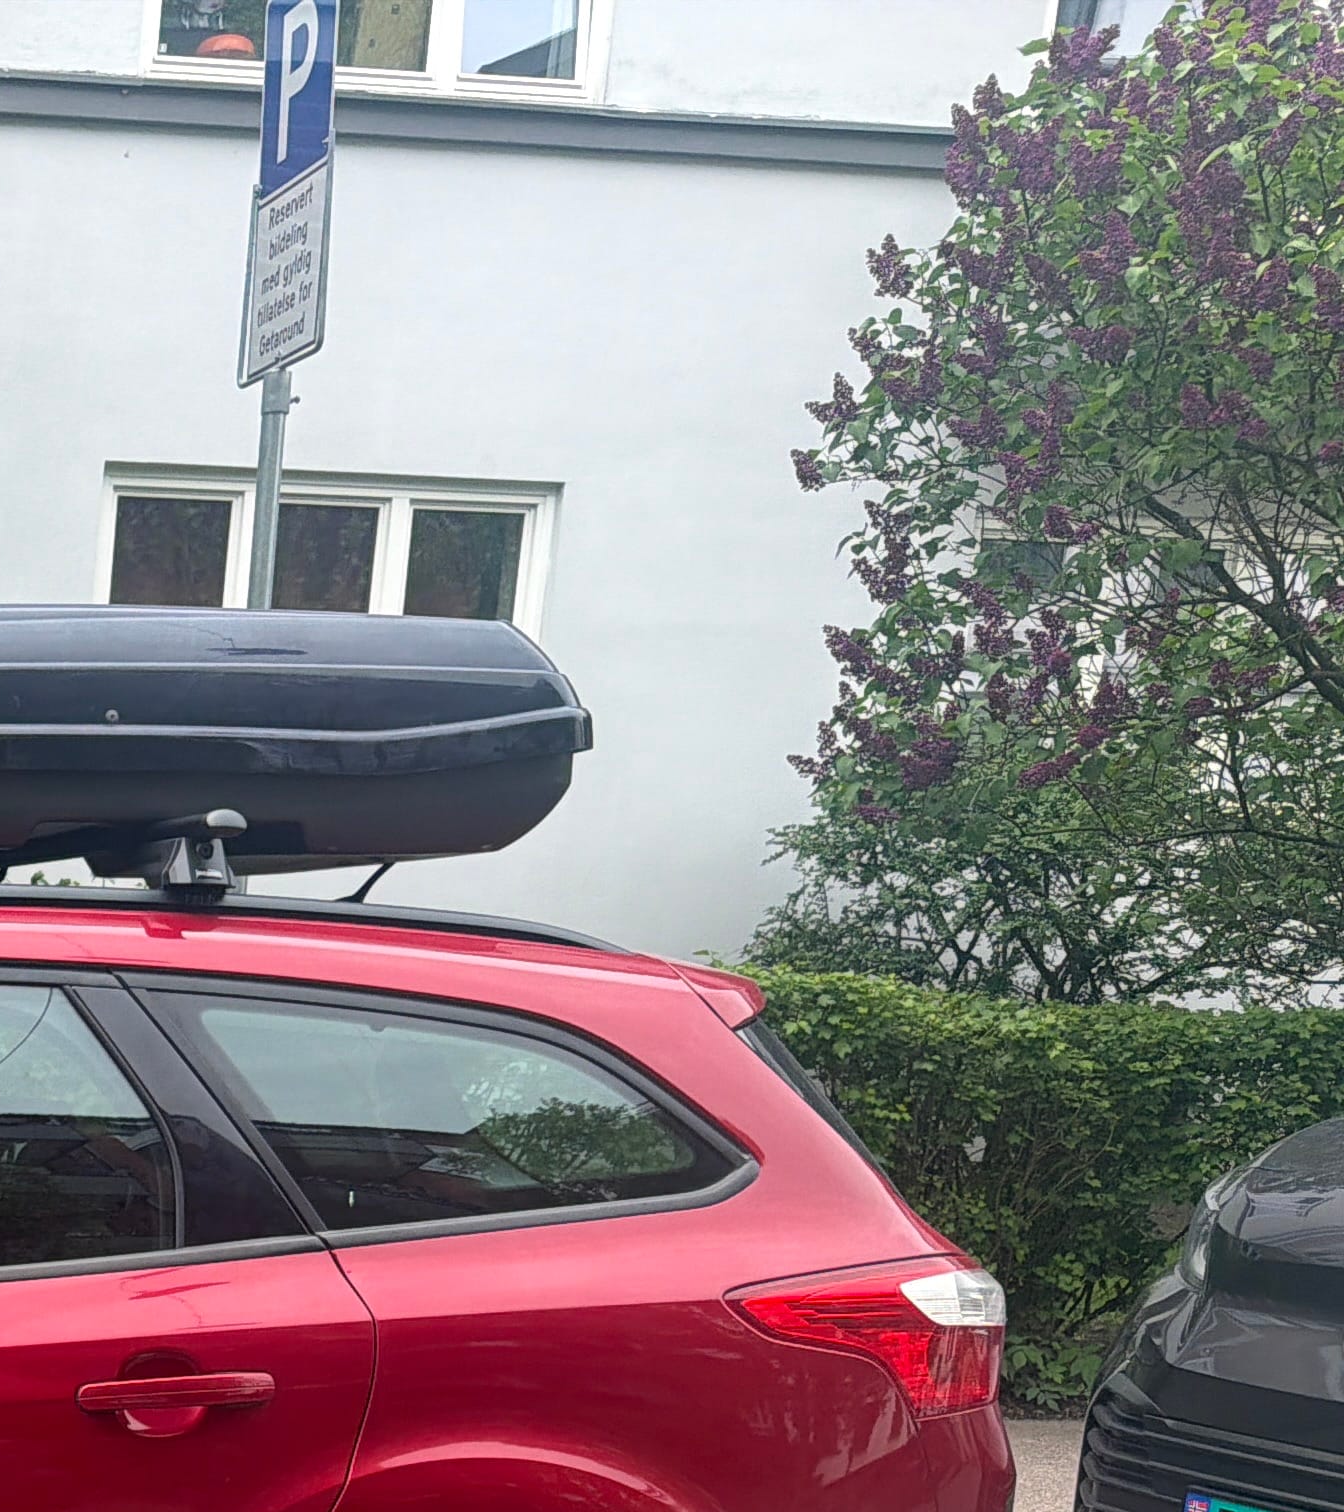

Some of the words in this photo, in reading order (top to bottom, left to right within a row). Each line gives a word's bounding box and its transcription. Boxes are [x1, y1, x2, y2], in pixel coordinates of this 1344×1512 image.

[276, 0, 318, 164] P
[268, 180, 313, 230] Reservert
[268, 221, 308, 261] bildeling
[261, 264, 281, 296] med
[282, 248, 312, 289] gyldig
[257, 291, 295, 329] tillatelse
[299, 280, 313, 304] for
[259, 310, 305, 357] Getaround
